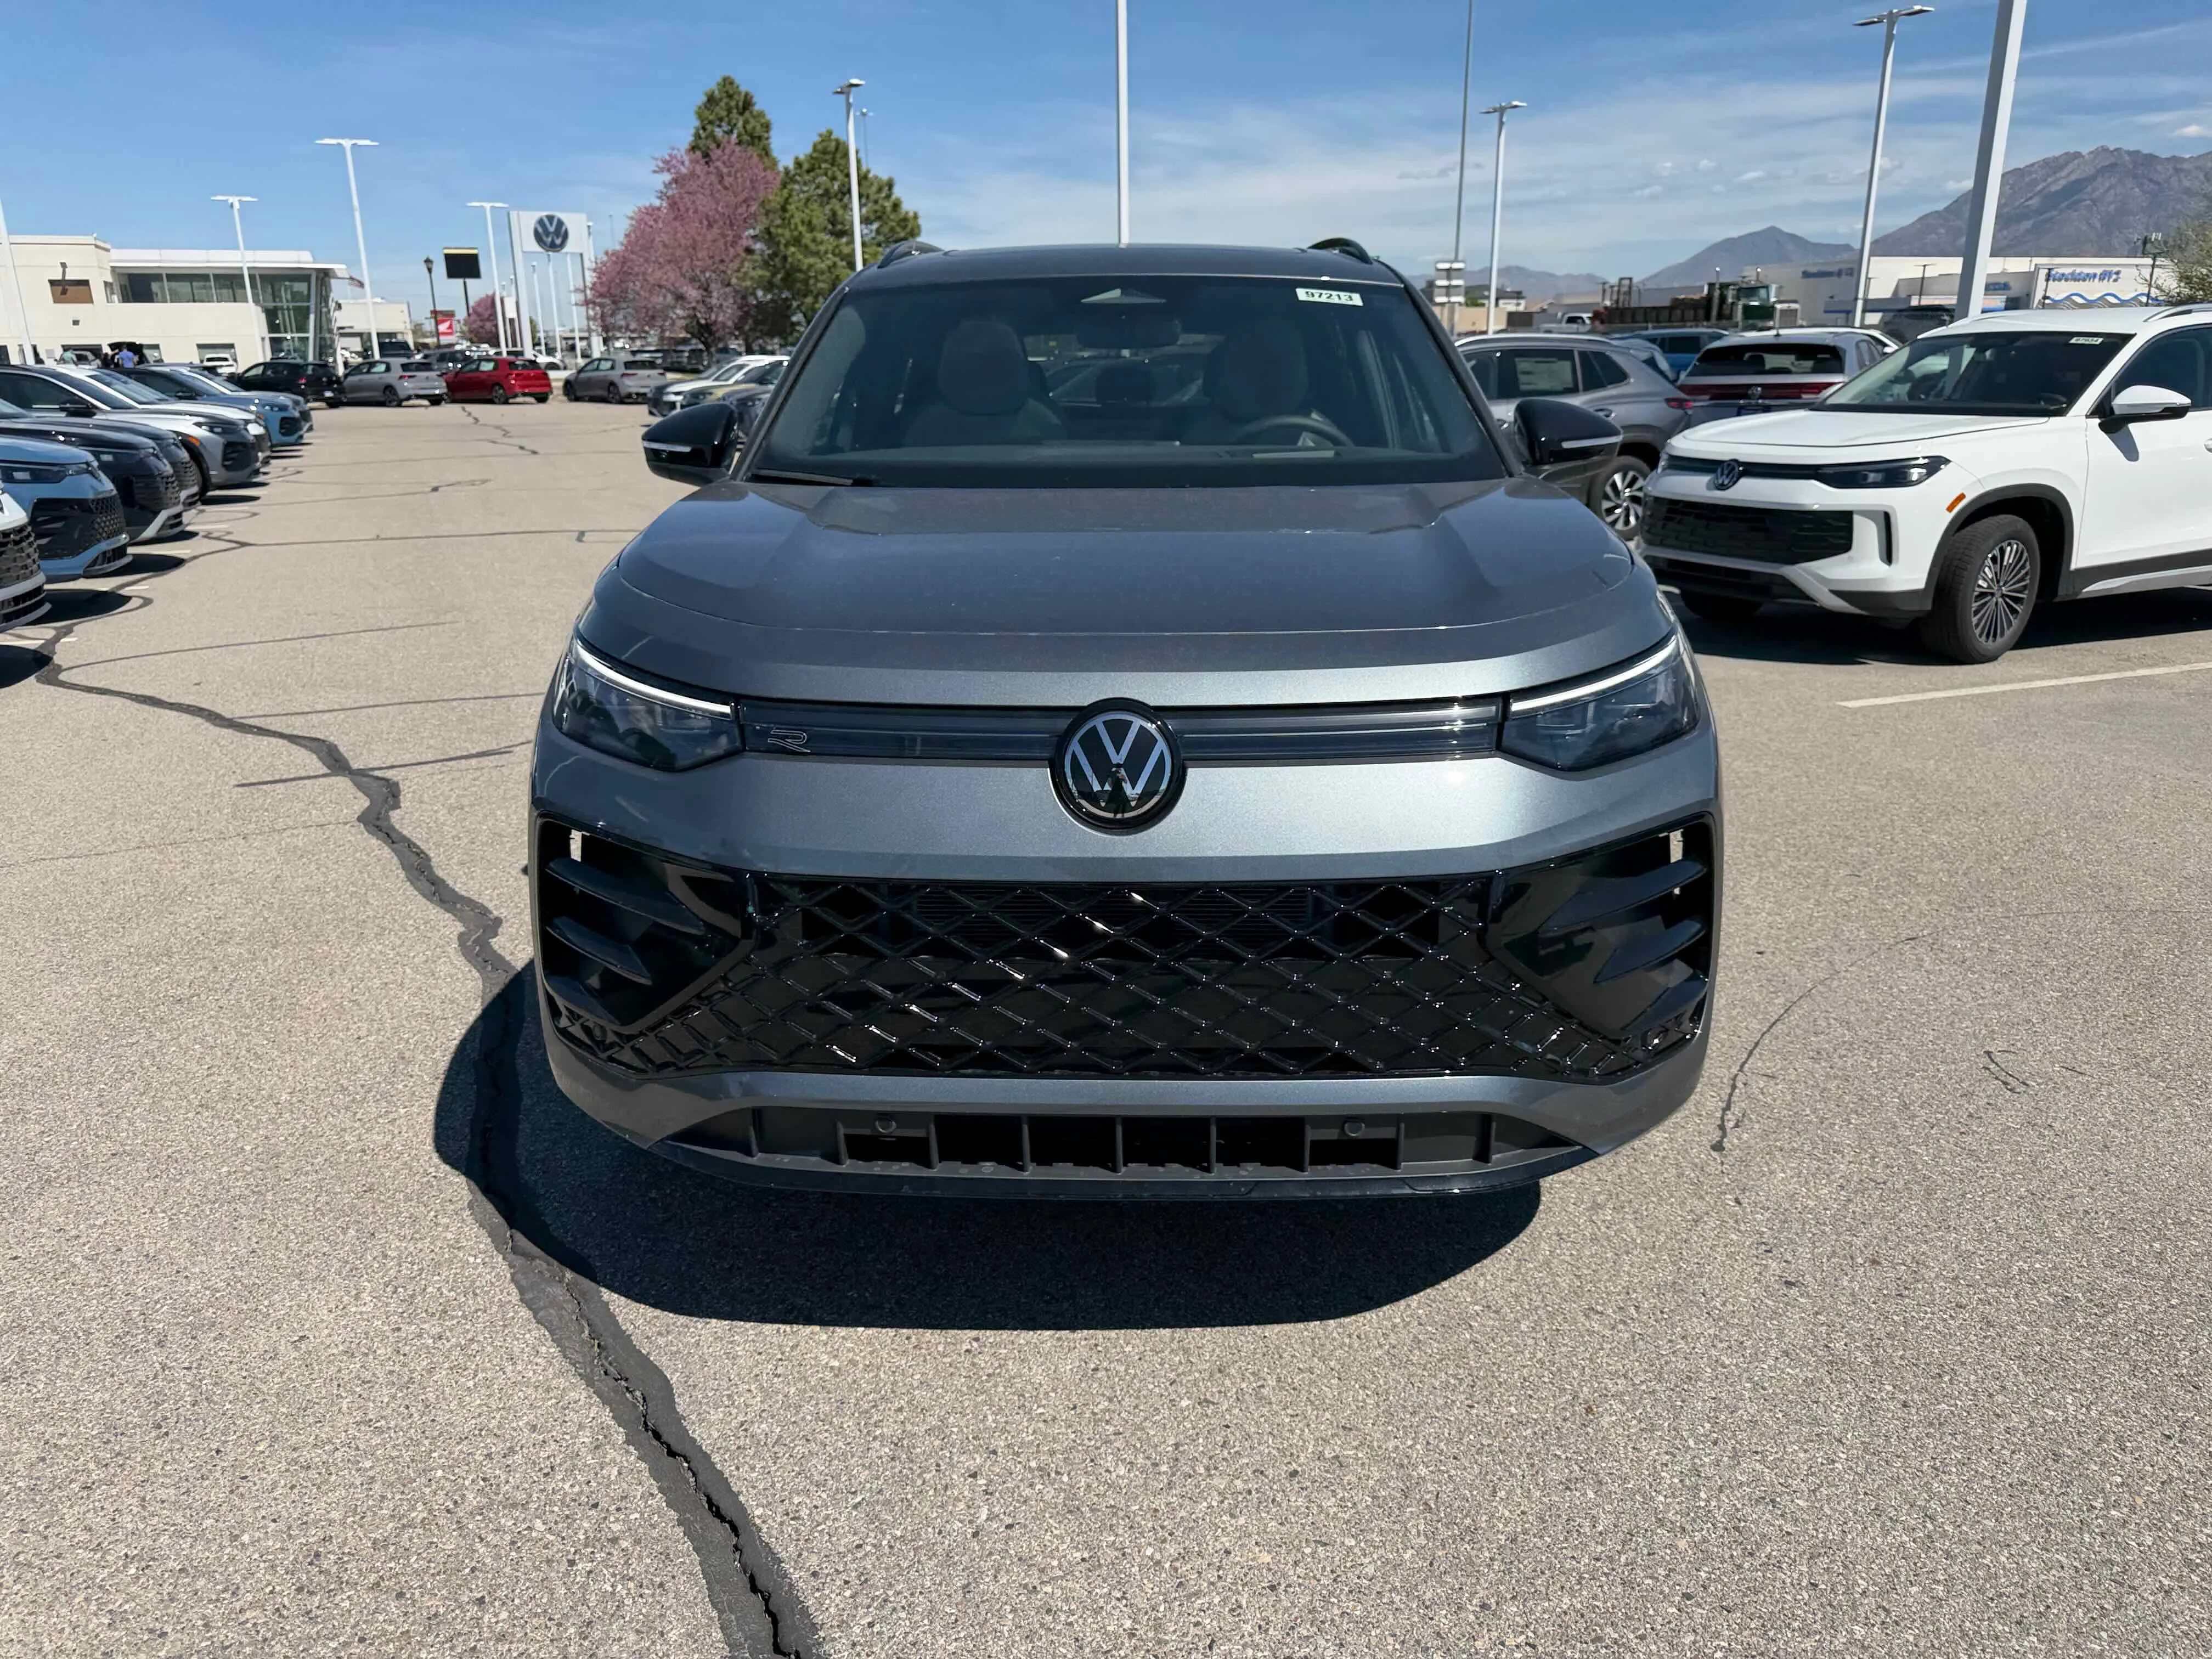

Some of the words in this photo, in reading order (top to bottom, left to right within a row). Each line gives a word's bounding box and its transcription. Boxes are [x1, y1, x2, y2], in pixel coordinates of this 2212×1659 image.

[535, 215, 567, 247] VW
[1305, 291, 1353, 301] 97213
[768, 729, 811, 752] R
[1069, 715, 1167, 809] VW
